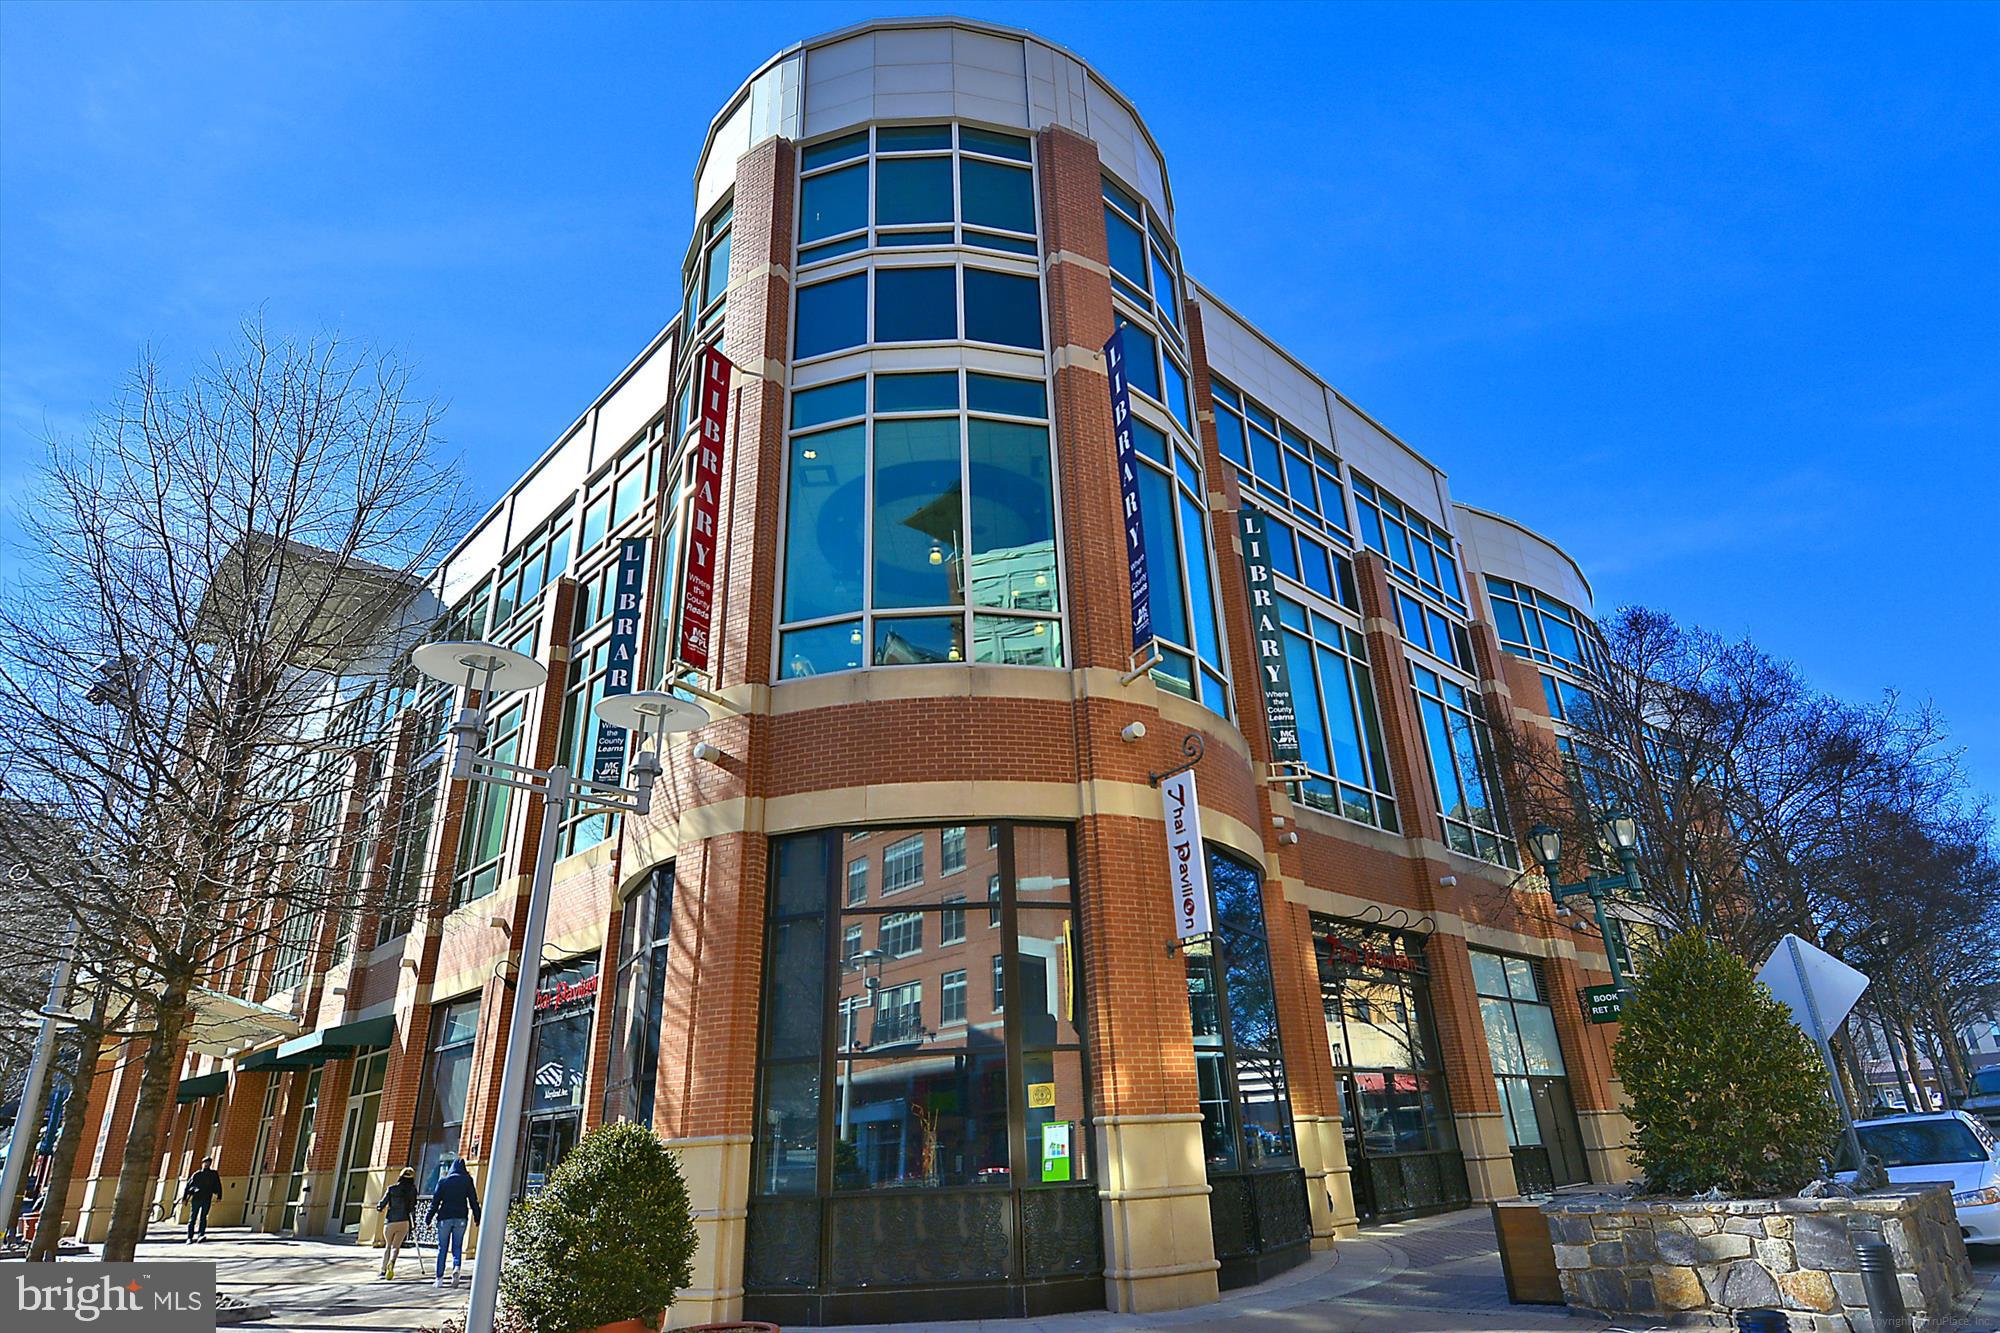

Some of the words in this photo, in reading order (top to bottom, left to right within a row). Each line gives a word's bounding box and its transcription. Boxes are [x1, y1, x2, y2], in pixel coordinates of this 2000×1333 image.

[694, 359, 725, 568] LIBRARY
[1109, 346, 1140, 549] LIBRARY
[686, 592, 710, 611] County
[688, 572, 711, 590] Where
[693, 585, 704, 597] the
[1244, 517, 1281, 683] LIBRARY
[610, 545, 640, 687] LIBRAR
[686, 603, 710, 620] Reads
[1167, 783, 1186, 835] Thai
[1173, 840, 1195, 929] Pavilion
[554, 976, 598, 1013] Pavilion
[1593, 993, 1618, 1003] BOOK
